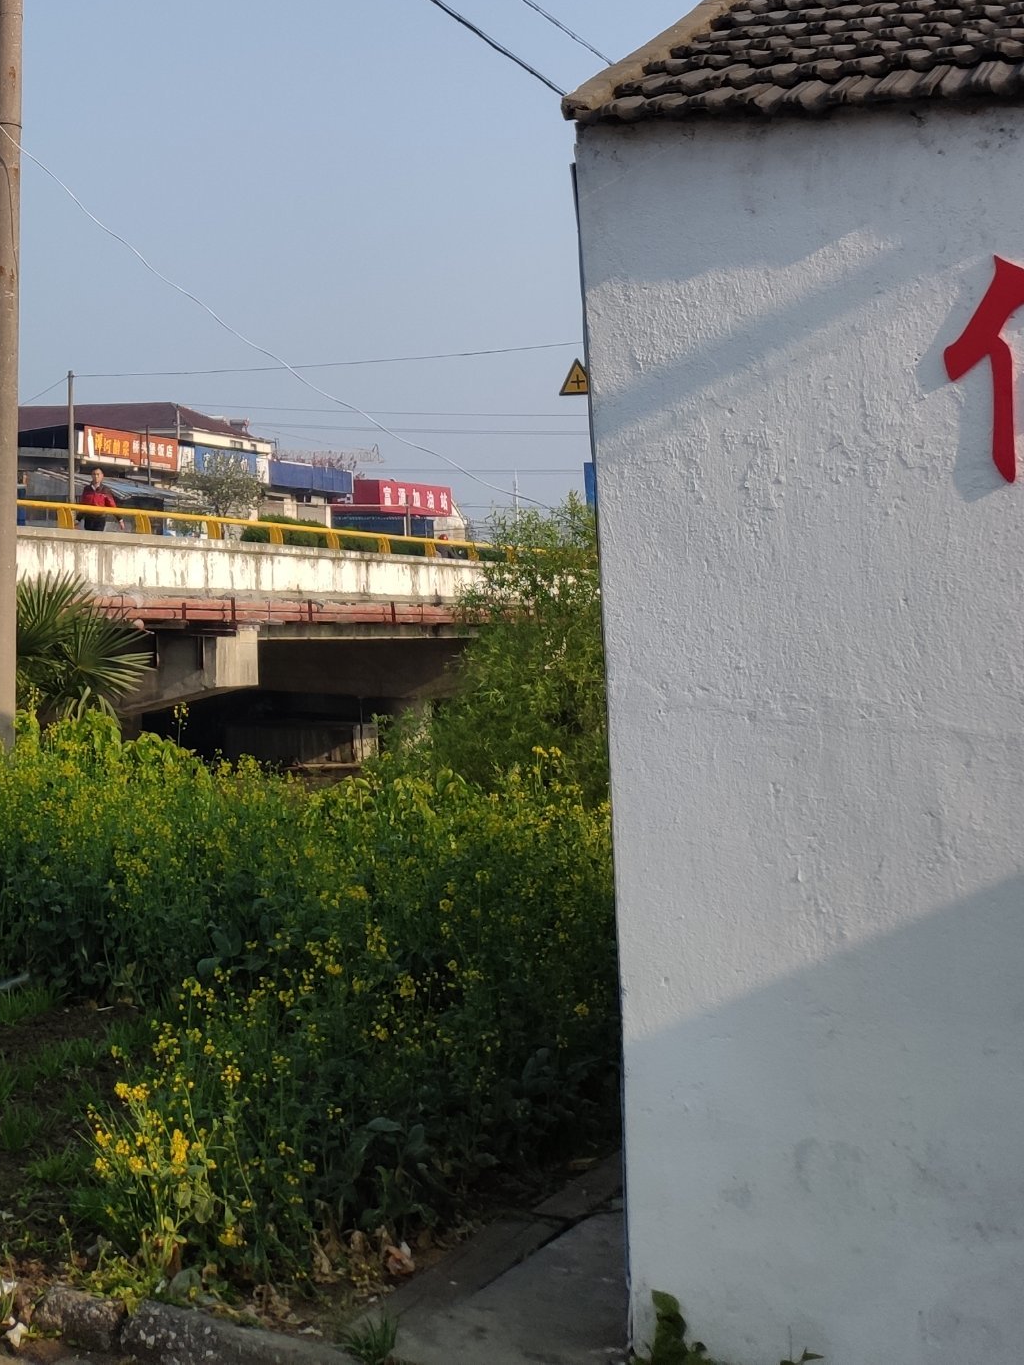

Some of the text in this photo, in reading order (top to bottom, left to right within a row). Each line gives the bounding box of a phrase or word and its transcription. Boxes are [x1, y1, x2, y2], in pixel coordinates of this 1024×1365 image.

[383, 486, 448, 511] 富源加油站
